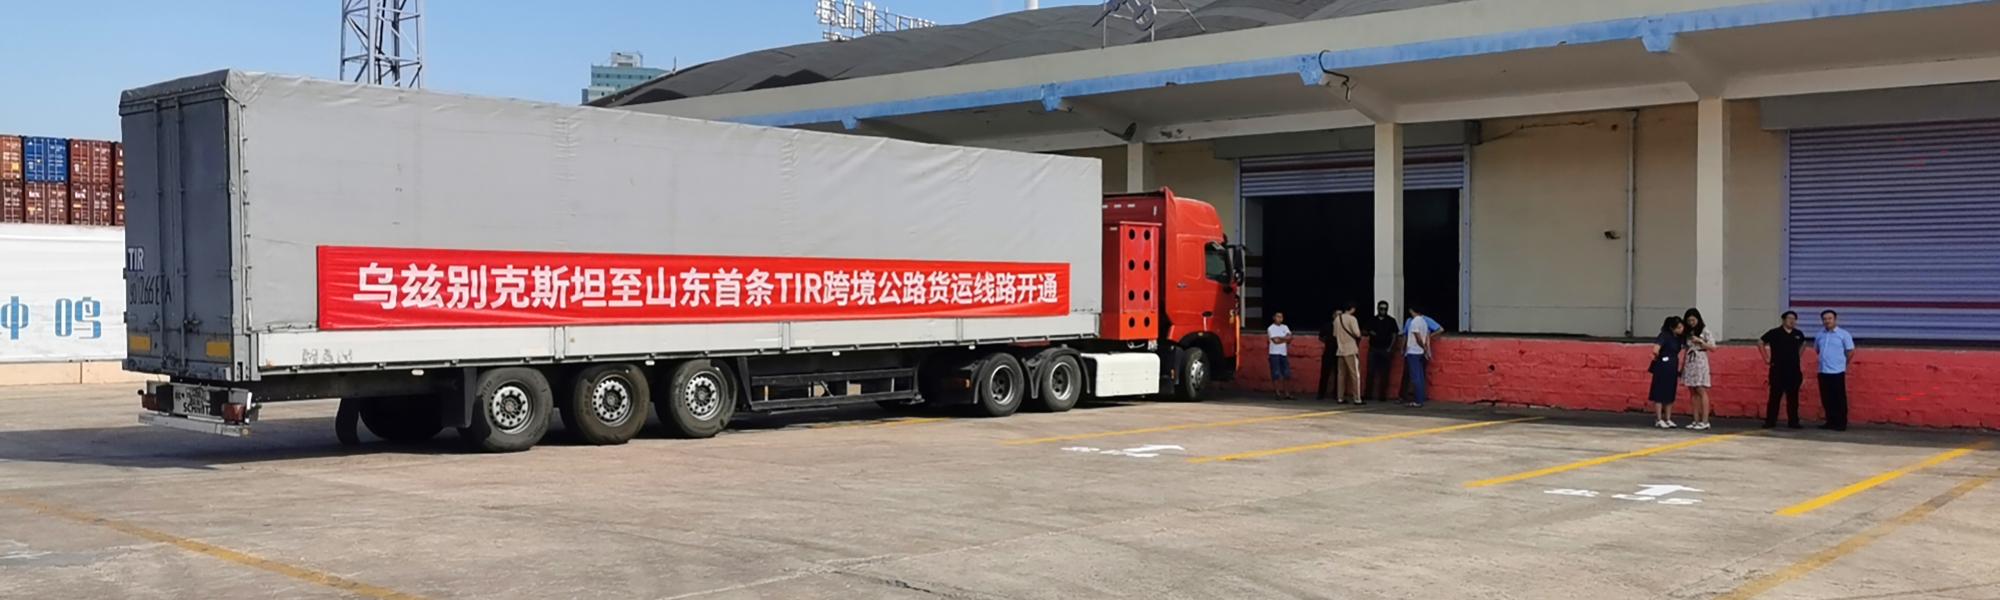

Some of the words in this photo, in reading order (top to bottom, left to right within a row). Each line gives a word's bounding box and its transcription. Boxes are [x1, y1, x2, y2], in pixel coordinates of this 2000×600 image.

[127, 247, 144, 271] TIR
[352, 261, 1058, 310] 乌兹别克斯坦至山东首条TIR跨境公路货运线路开通
